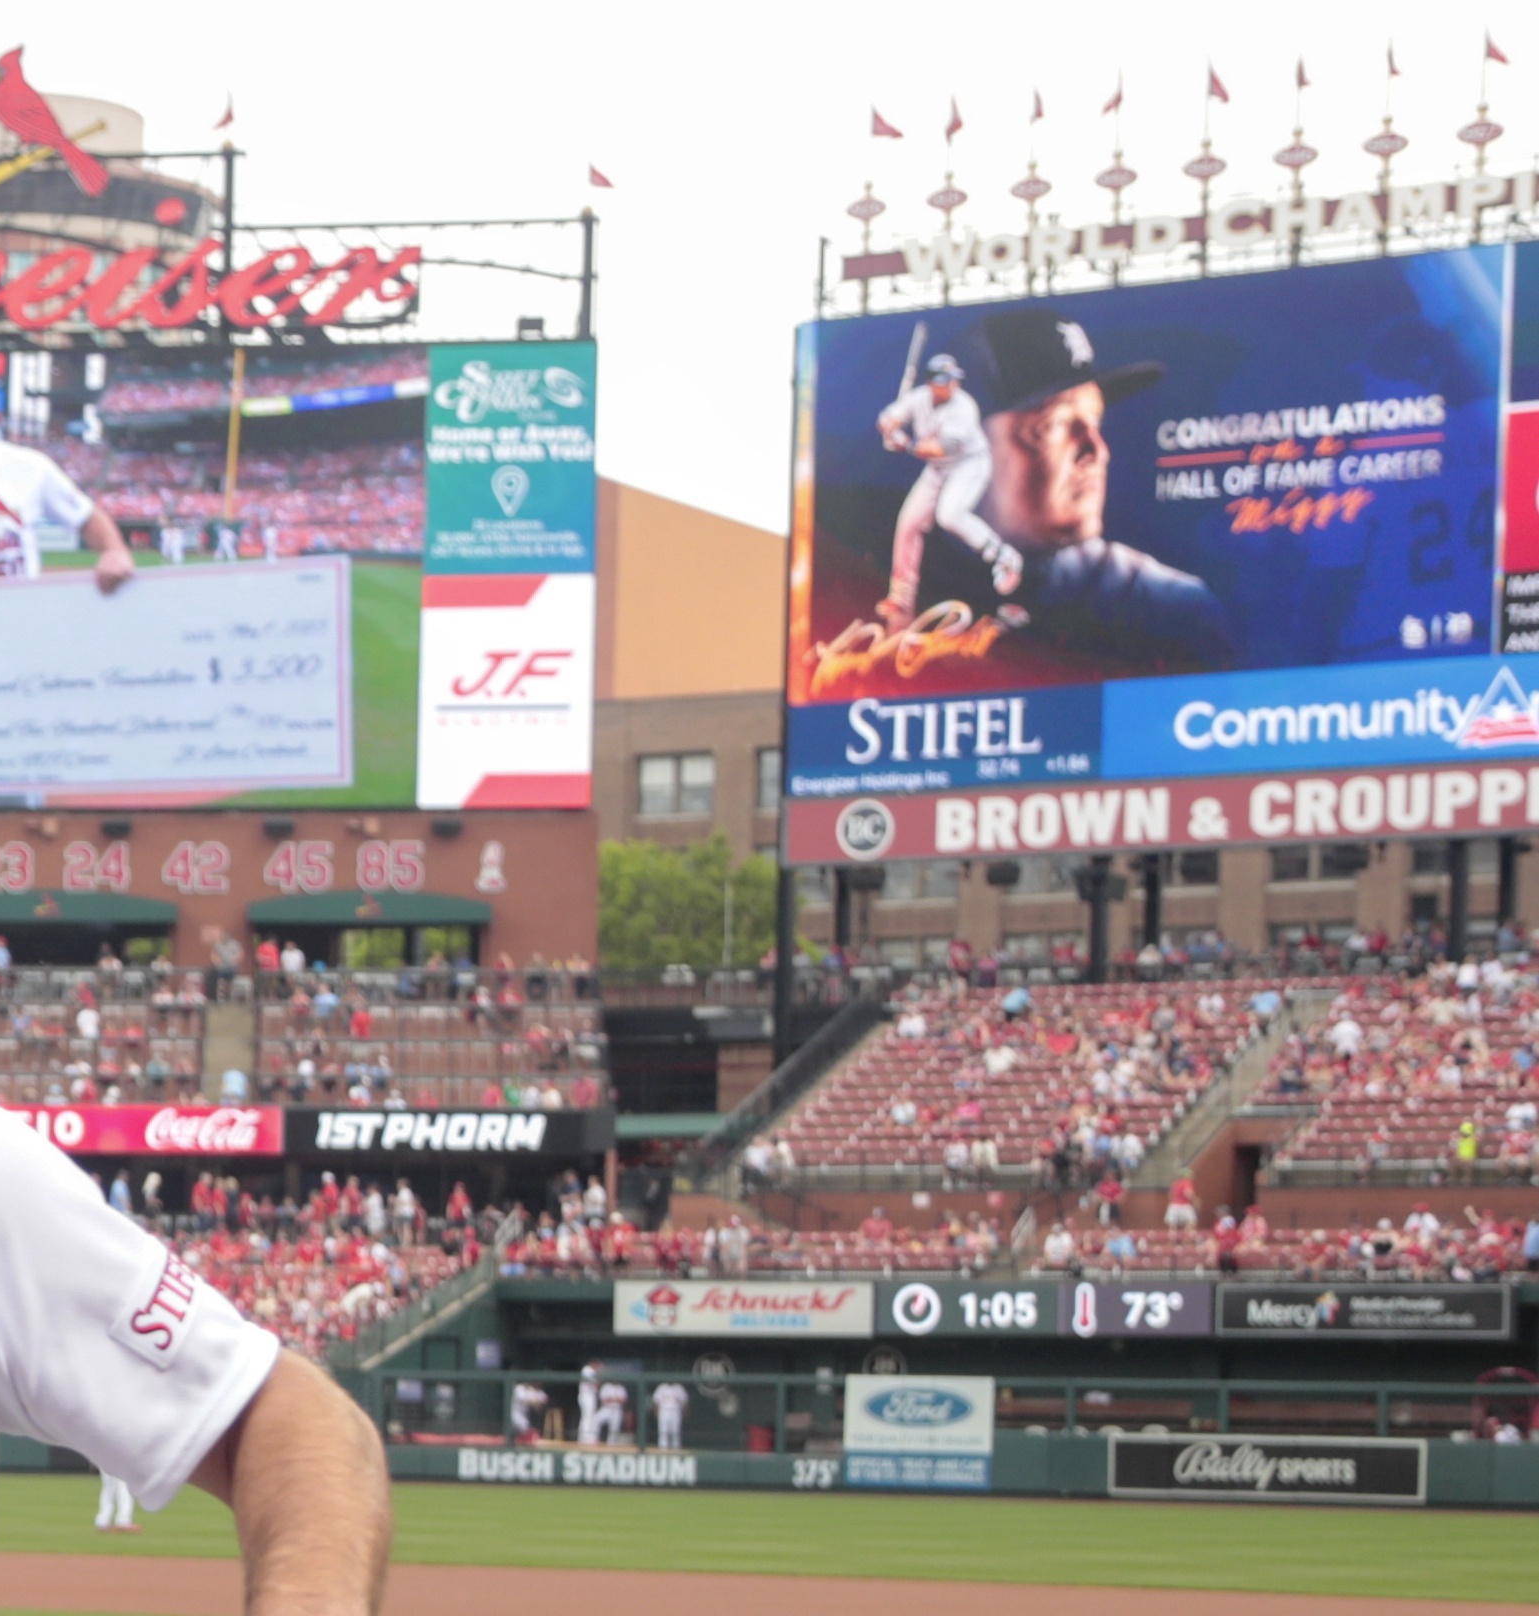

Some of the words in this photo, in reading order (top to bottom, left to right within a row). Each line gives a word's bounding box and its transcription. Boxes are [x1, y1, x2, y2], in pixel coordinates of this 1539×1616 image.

[903, 213, 1186, 283] WORLD
[1157, 395, 1445, 450] CONGRATULATIONS
[1155, 470, 1219, 500] HALL
[1223, 464, 1260, 495] OF
[1265, 457, 1334, 490] FAME
[1339, 450, 1442, 485] CAREER
[846, 697, 1043, 765] STIFEL
[1174, 687, 1483, 752] Community
[935, 788, 1170, 855] BROWN
[1189, 796, 1228, 839] &
[62, 841, 130, 894] 24
[161, 841, 231, 894] 42
[263, 841, 334, 894] 45
[356, 841, 425, 894] 85
[380, 1112, 547, 1152] PHORM
[959, 1291, 1038, 1328] 1:05
[1122, 1291, 1183, 1329] 73°
[1247, 1300, 1319, 1331] Mercy
[881, 1389, 952, 1423] Ford
[458, 1449, 555, 1482] BUSCH
[562, 1452, 697, 1486] STADIUM
[1174, 1441, 1278, 1491] Bally
[1278, 1457, 1356, 1485] SPORTS
